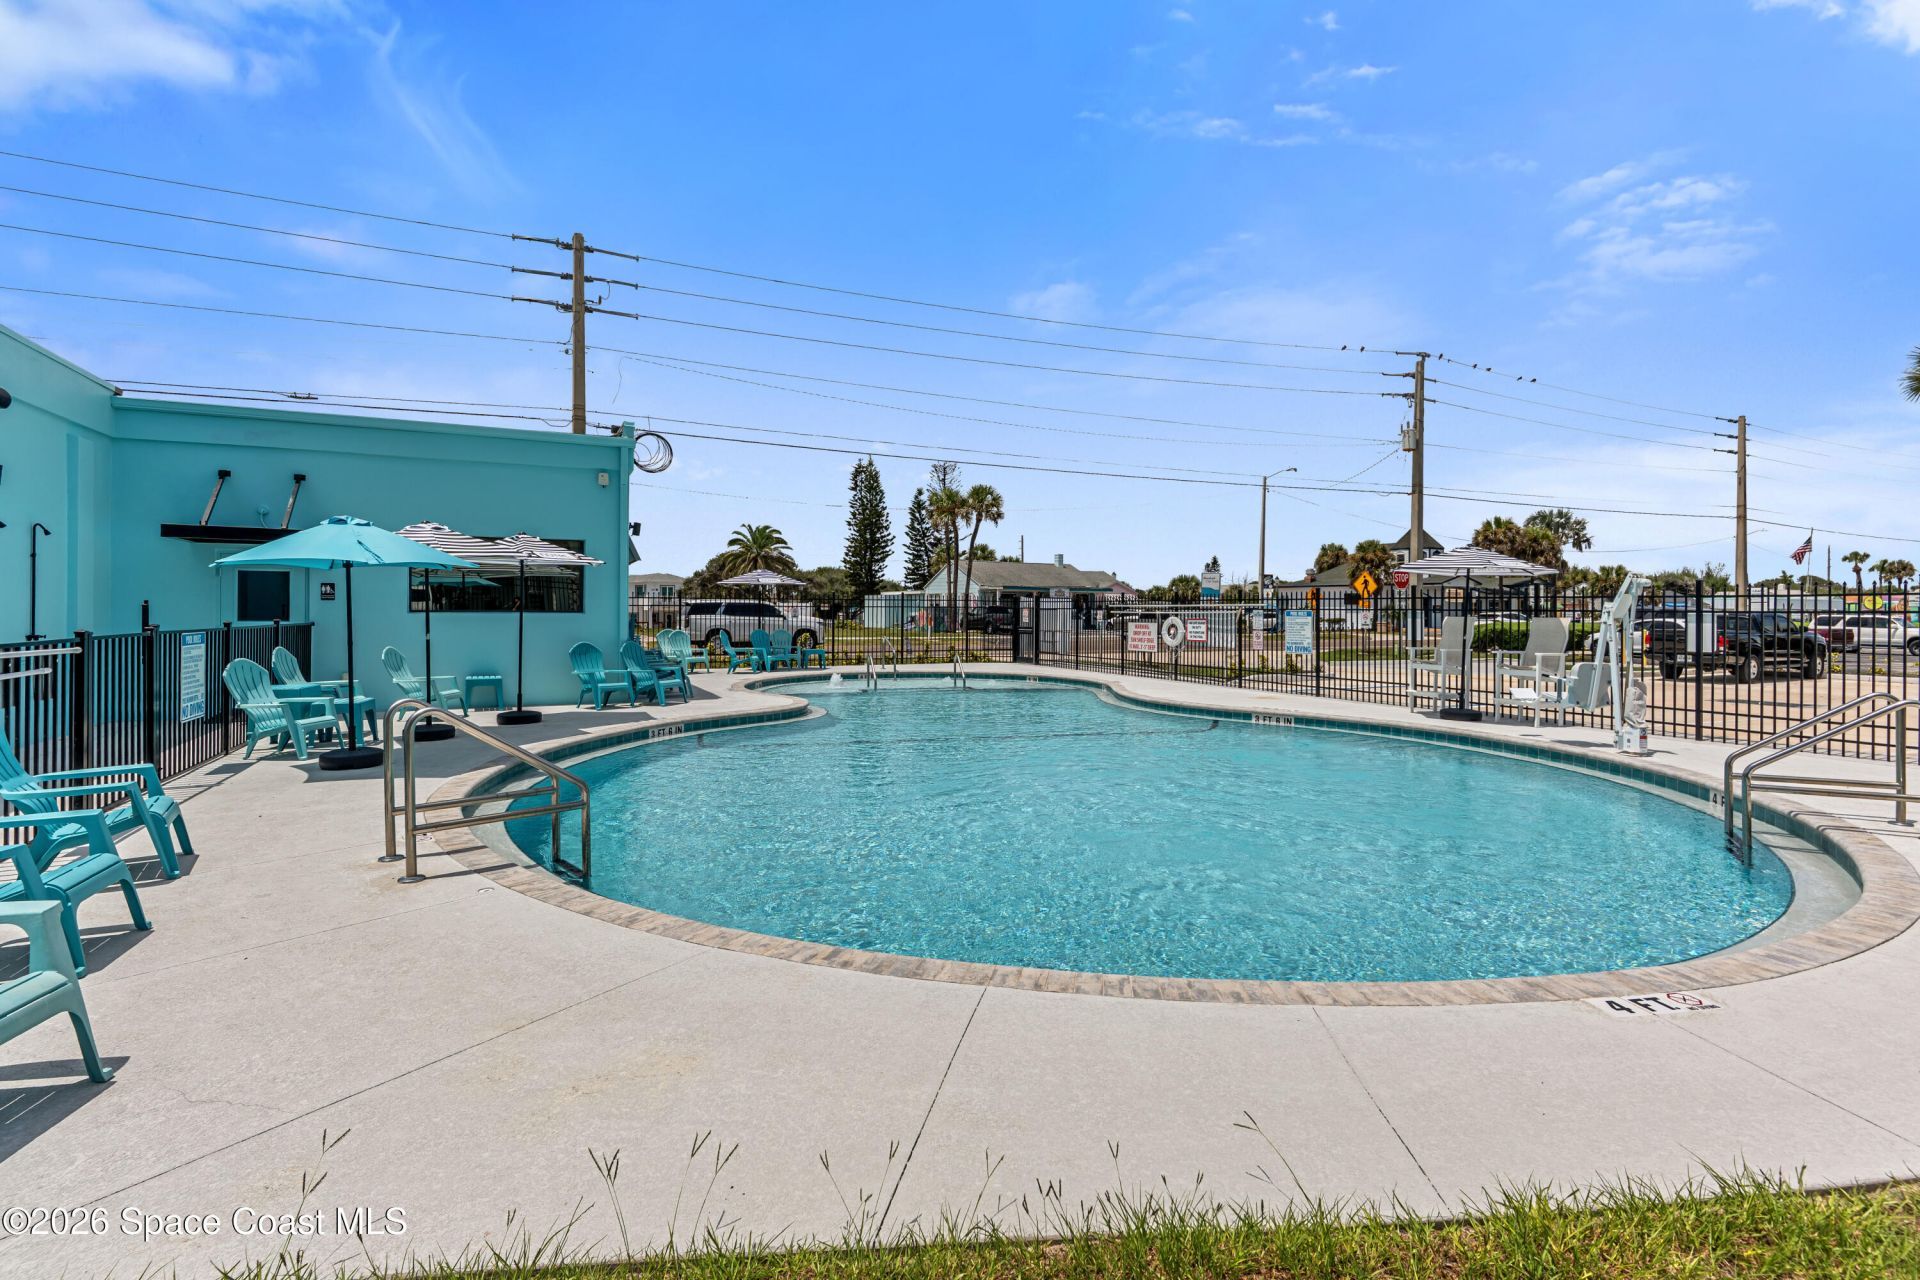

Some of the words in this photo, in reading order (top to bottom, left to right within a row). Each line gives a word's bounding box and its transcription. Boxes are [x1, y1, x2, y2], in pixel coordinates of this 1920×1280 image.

[1394, 573, 1409, 582] STOP
[1294, 645, 1311, 653] DIVING
[182, 704, 189, 719] NO
[1254, 714, 1260, 723] 3
[1263, 715, 1272, 723] FT
[1284, 717, 1292, 725] IN
[657, 728, 666, 737] FT
[675, 725, 683, 734] IN
[1712, 793, 1718, 804] 4
[1605, 1000, 1636, 1014] 4
[1628, 996, 1681, 1012] FT.
